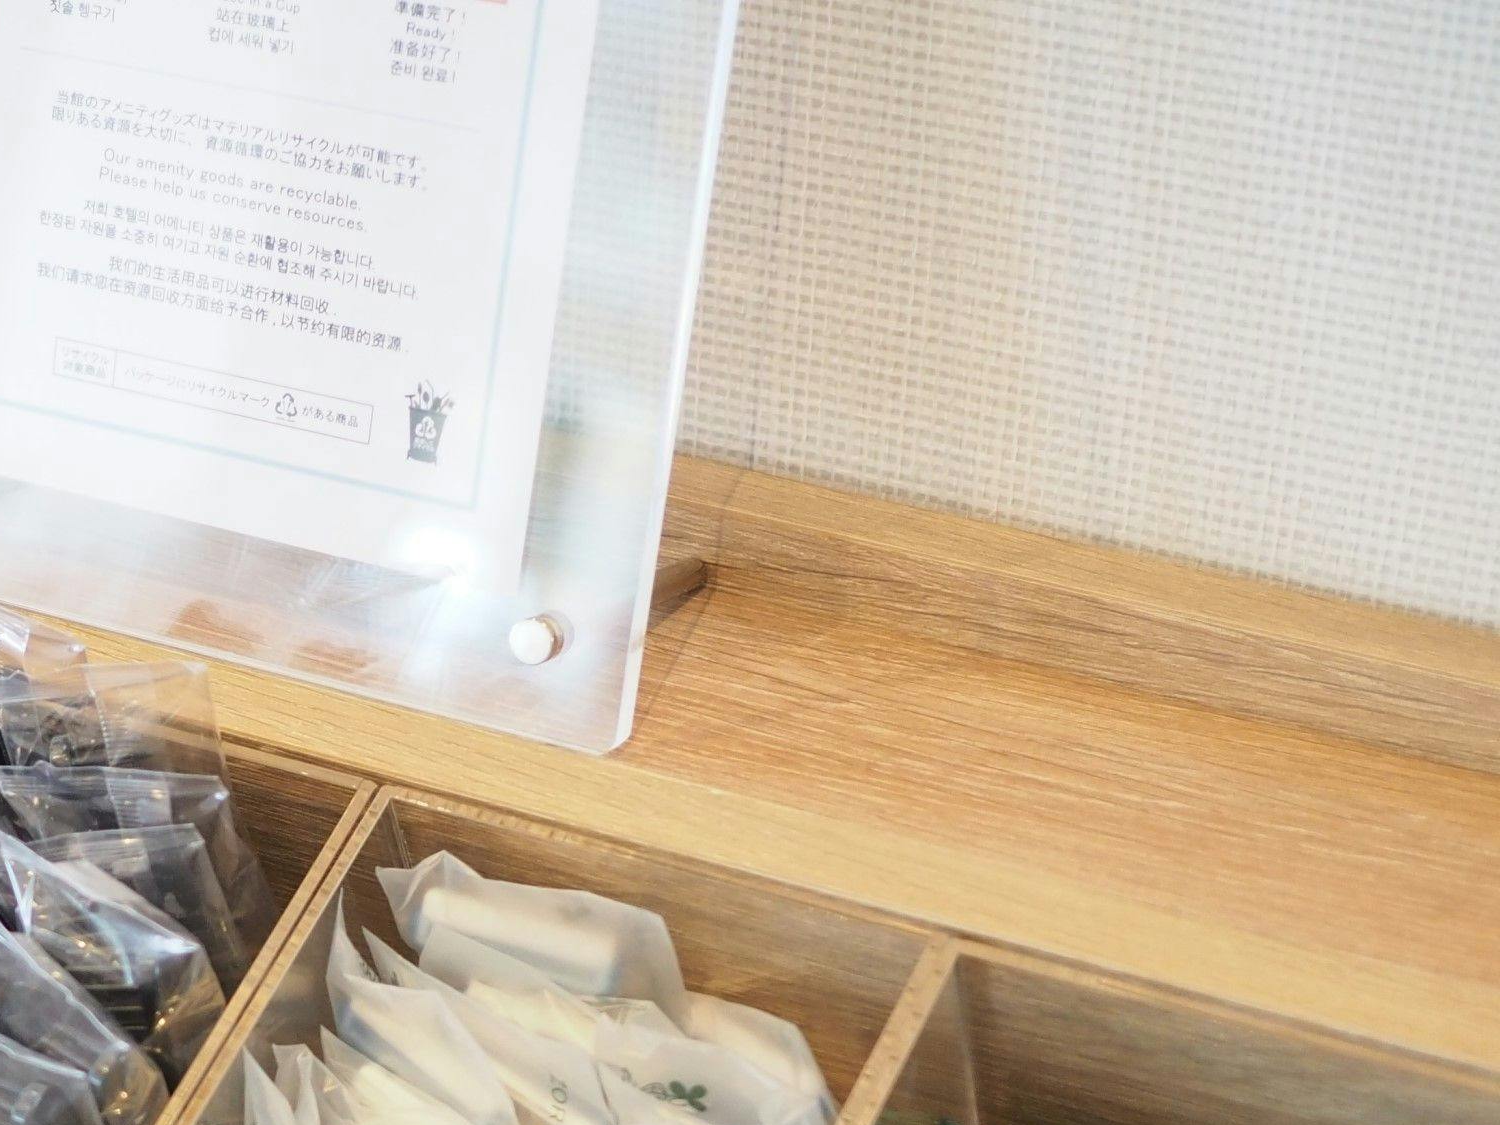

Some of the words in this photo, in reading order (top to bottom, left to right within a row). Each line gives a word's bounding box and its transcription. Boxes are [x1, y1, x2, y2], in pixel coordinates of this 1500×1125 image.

[99, 166, 148, 190] Please
[154, 178, 184, 198] help
[190, 188, 207, 202] us
[212, 193, 281, 216] conserve
[287, 205, 369, 233] resources.
[104, 147, 131, 165] Our
[136, 157, 195, 182] amenity
[200, 170, 244, 188] goods
[250, 179, 274, 194] are
[280, 185, 363, 212] recyclable.
[154, 212, 204, 237] 어메니티
